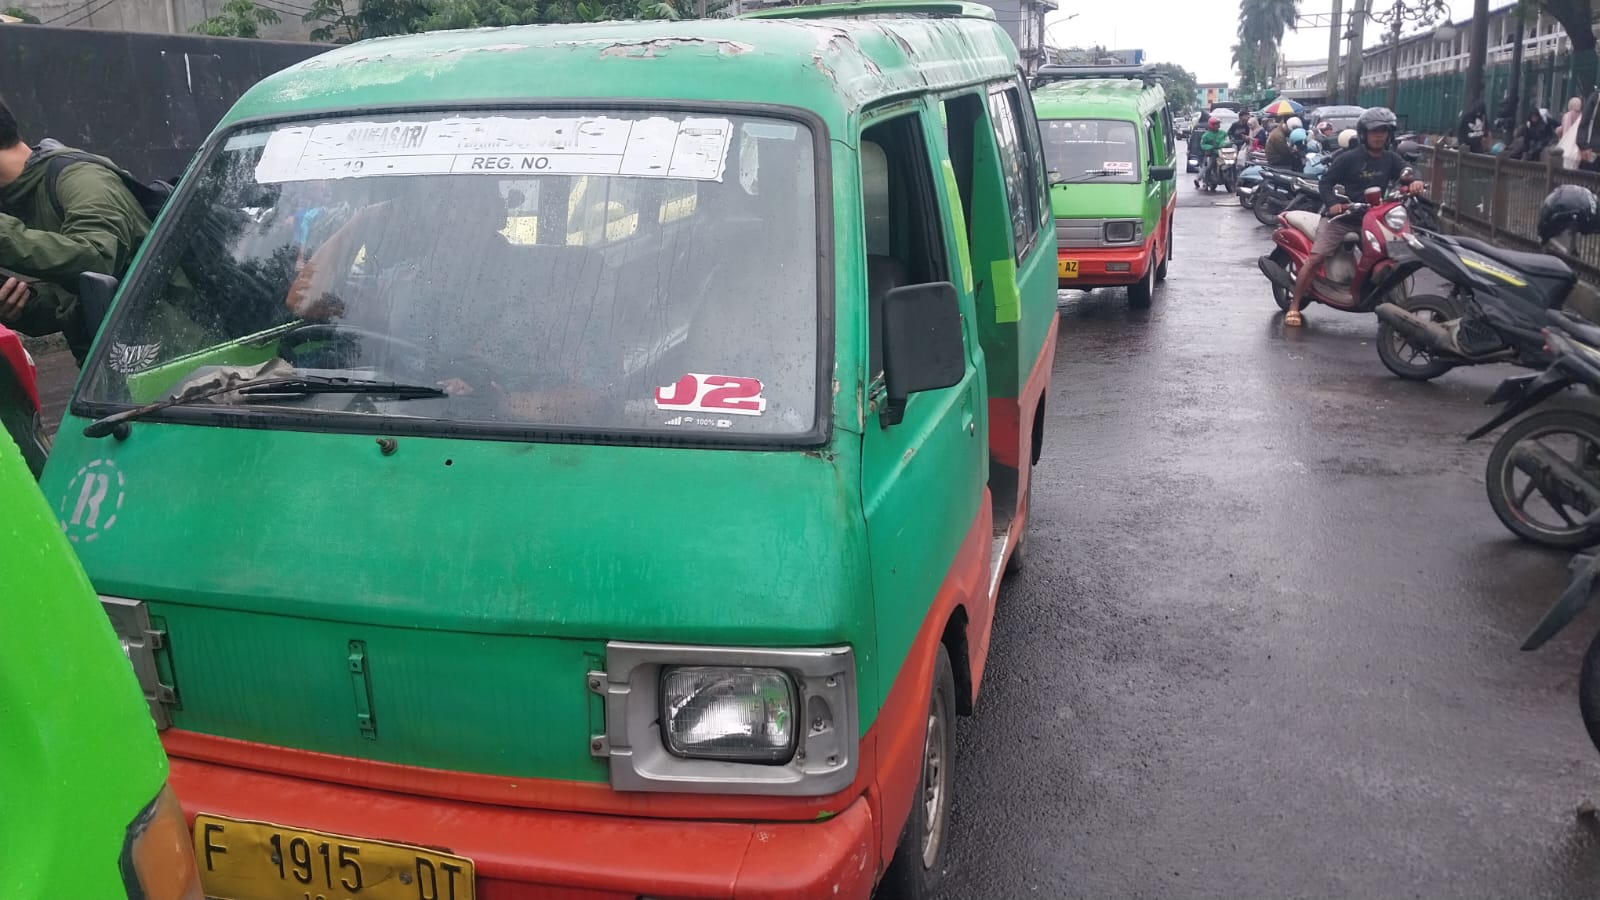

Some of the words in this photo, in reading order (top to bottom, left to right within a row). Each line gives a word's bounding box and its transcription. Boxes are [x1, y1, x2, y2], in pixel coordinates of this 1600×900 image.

[471, 156, 515, 171] REG.
[521, 156, 552, 170] NO.
[696, 418, 715, 427] 100%
[70, 472, 108, 529] R
[204, 823, 227, 872] F
[269, 833, 363, 893] 1915
[415, 856, 463, 900] DT
